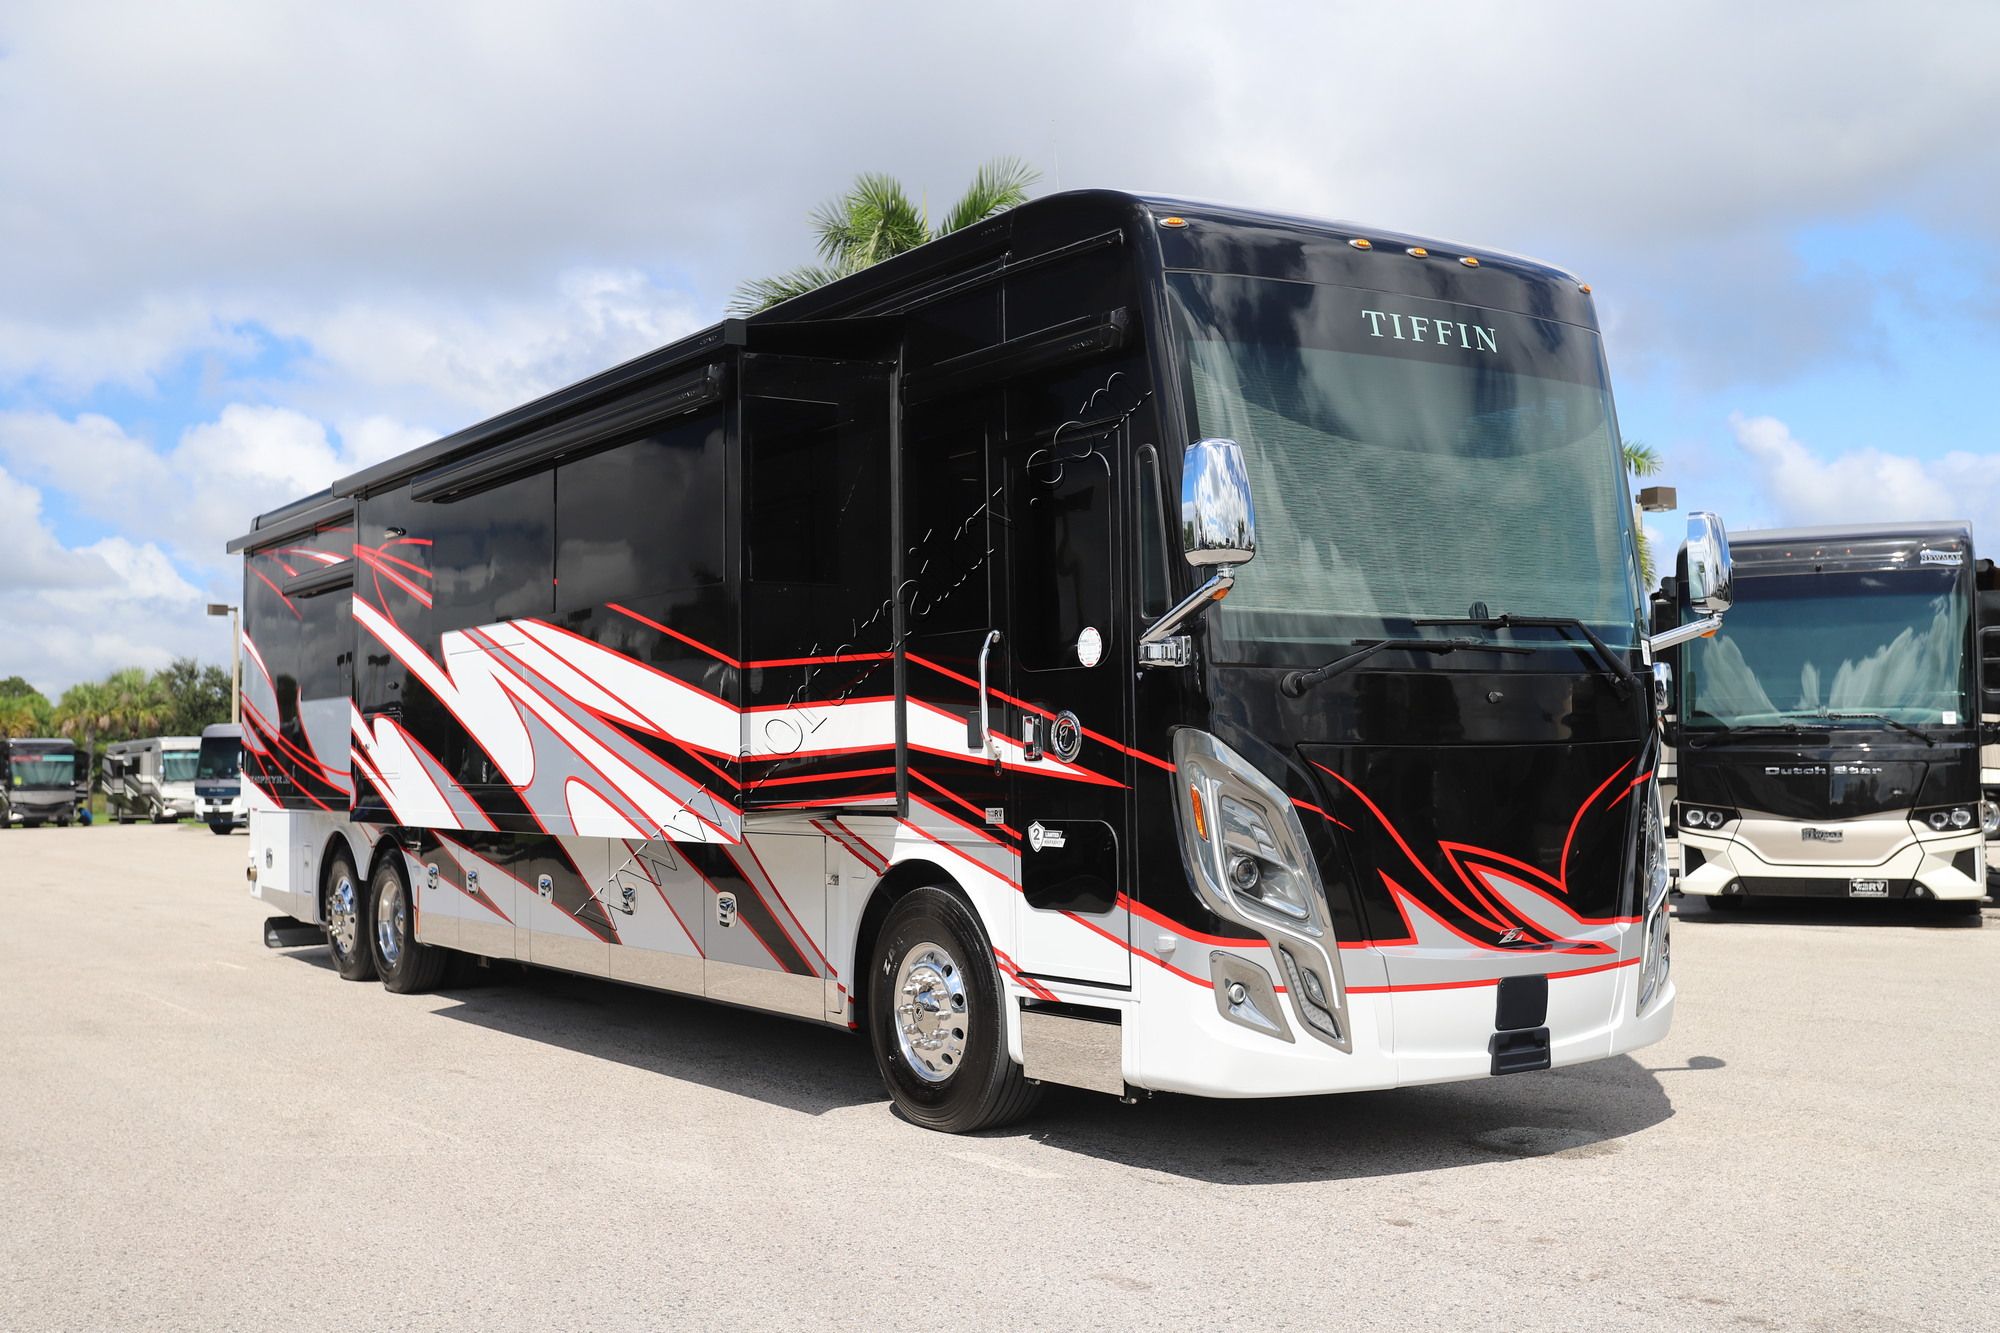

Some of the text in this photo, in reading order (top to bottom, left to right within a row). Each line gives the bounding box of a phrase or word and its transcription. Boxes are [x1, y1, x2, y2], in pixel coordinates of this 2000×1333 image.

[1361, 309, 1498, 353] TIFFIN
[1765, 765, 1882, 775] Dutch Star
[1033, 828, 1040, 841] 2
